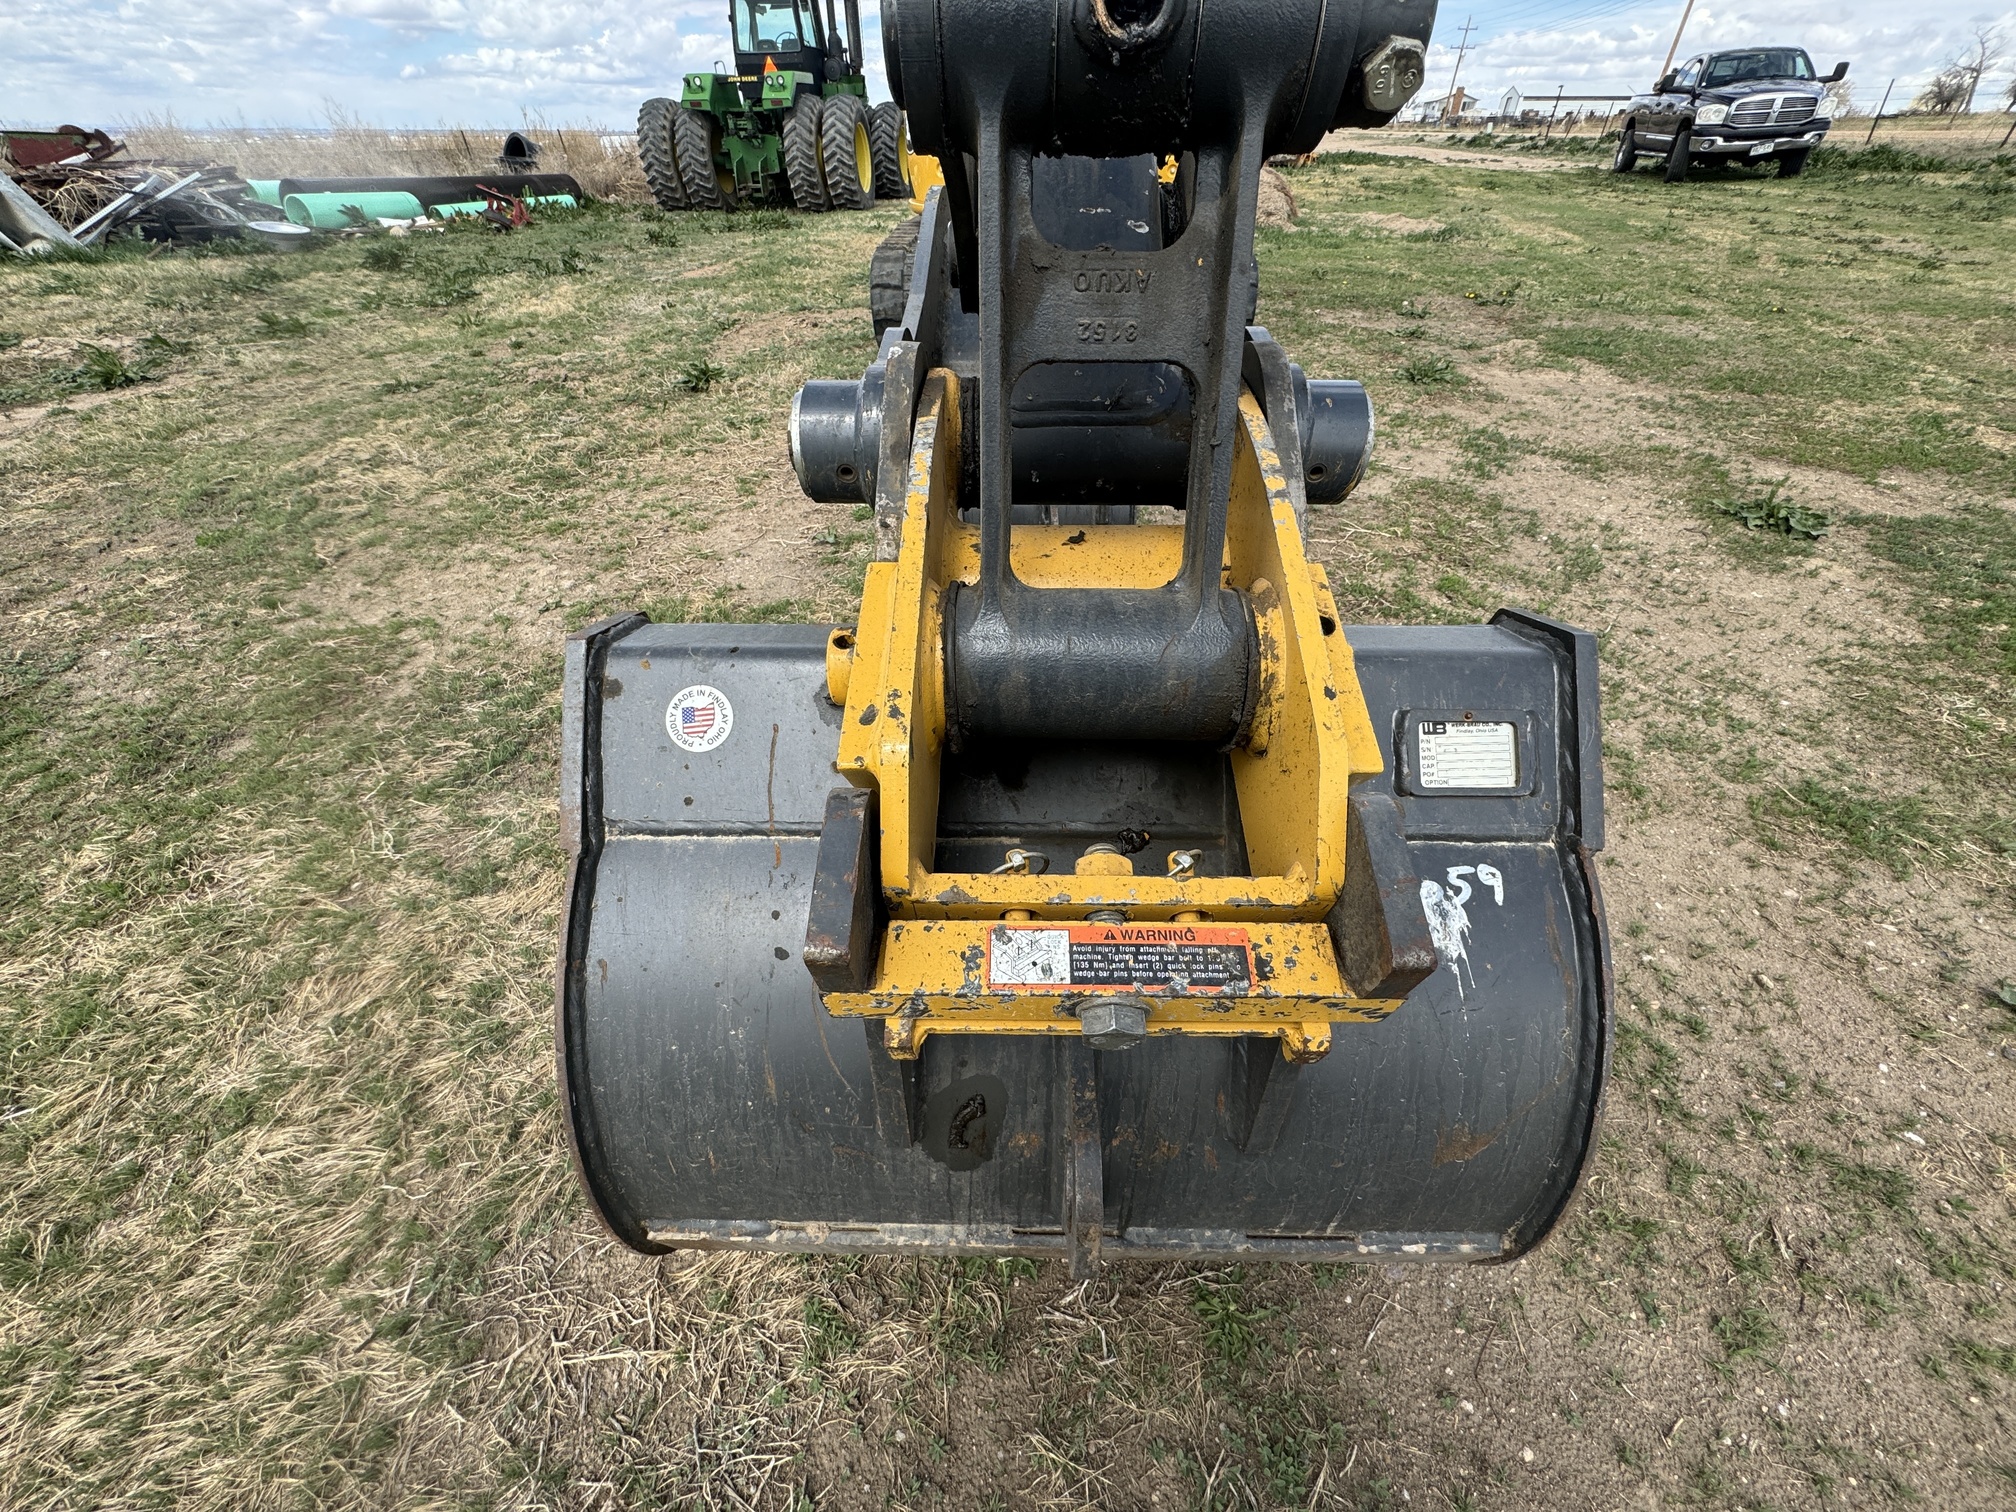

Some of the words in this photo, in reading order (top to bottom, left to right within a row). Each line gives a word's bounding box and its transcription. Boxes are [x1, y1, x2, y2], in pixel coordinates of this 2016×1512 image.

[696, 689, 706, 697] IN
[671, 690, 695, 711] MADE
[707, 691, 730, 726] FINDLAY
[669, 712, 695, 748] PROUDLY
[706, 726, 726, 746] OHIO
[1120, 929, 1196, 942] WARNING
[1072, 945, 1092, 953] Avoid
[1095, 945, 1116, 954] injury
[1119, 945, 1136, 953] from
[1072, 953, 1104, 961] machine.
[1137, 954, 1160, 963] wedge
[1163, 954, 1175, 962] bar
[1073, 961, 1090, 970] [135
[1093, 961, 1108, 970] Nm]
[1152, 963, 1163, 971] (2)
[1166, 963, 1187, 971] quick
[1113, 970, 1128, 978] pins
[1131, 970, 1154, 978] before
